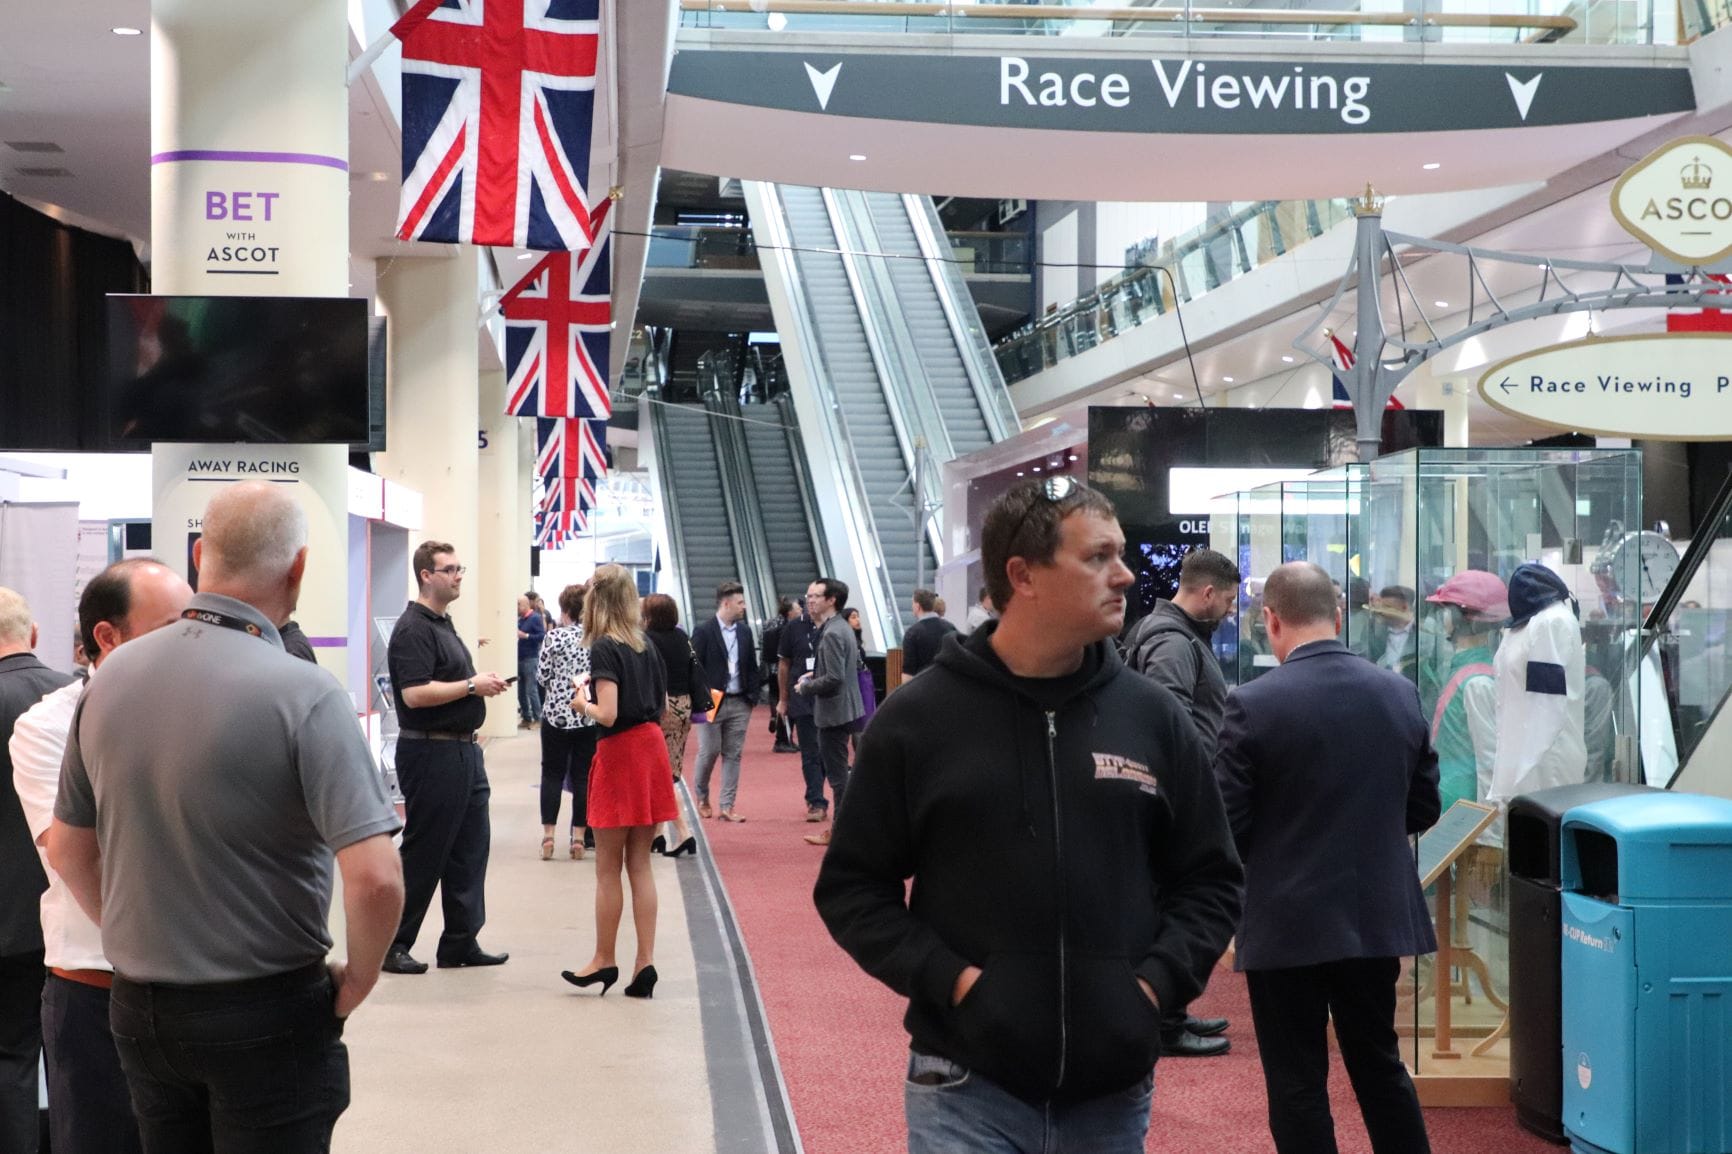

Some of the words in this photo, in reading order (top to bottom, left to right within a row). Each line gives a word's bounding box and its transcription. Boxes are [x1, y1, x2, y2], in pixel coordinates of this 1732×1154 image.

[1000, 57, 1131, 107] Race
[1152, 59, 1371, 125] Viewing
[206, 191, 279, 221] BET
[1641, 197, 1732, 220] ASCO
[226, 231, 255, 240] WITH
[207, 246, 279, 262] ASCOT
[1530, 376, 1586, 393] Race
[1597, 376, 1692, 398] Viewing
[1717, 376, 1730, 393] P
[188, 460, 231, 473] AWAY
[237, 461, 299, 473] RACING
